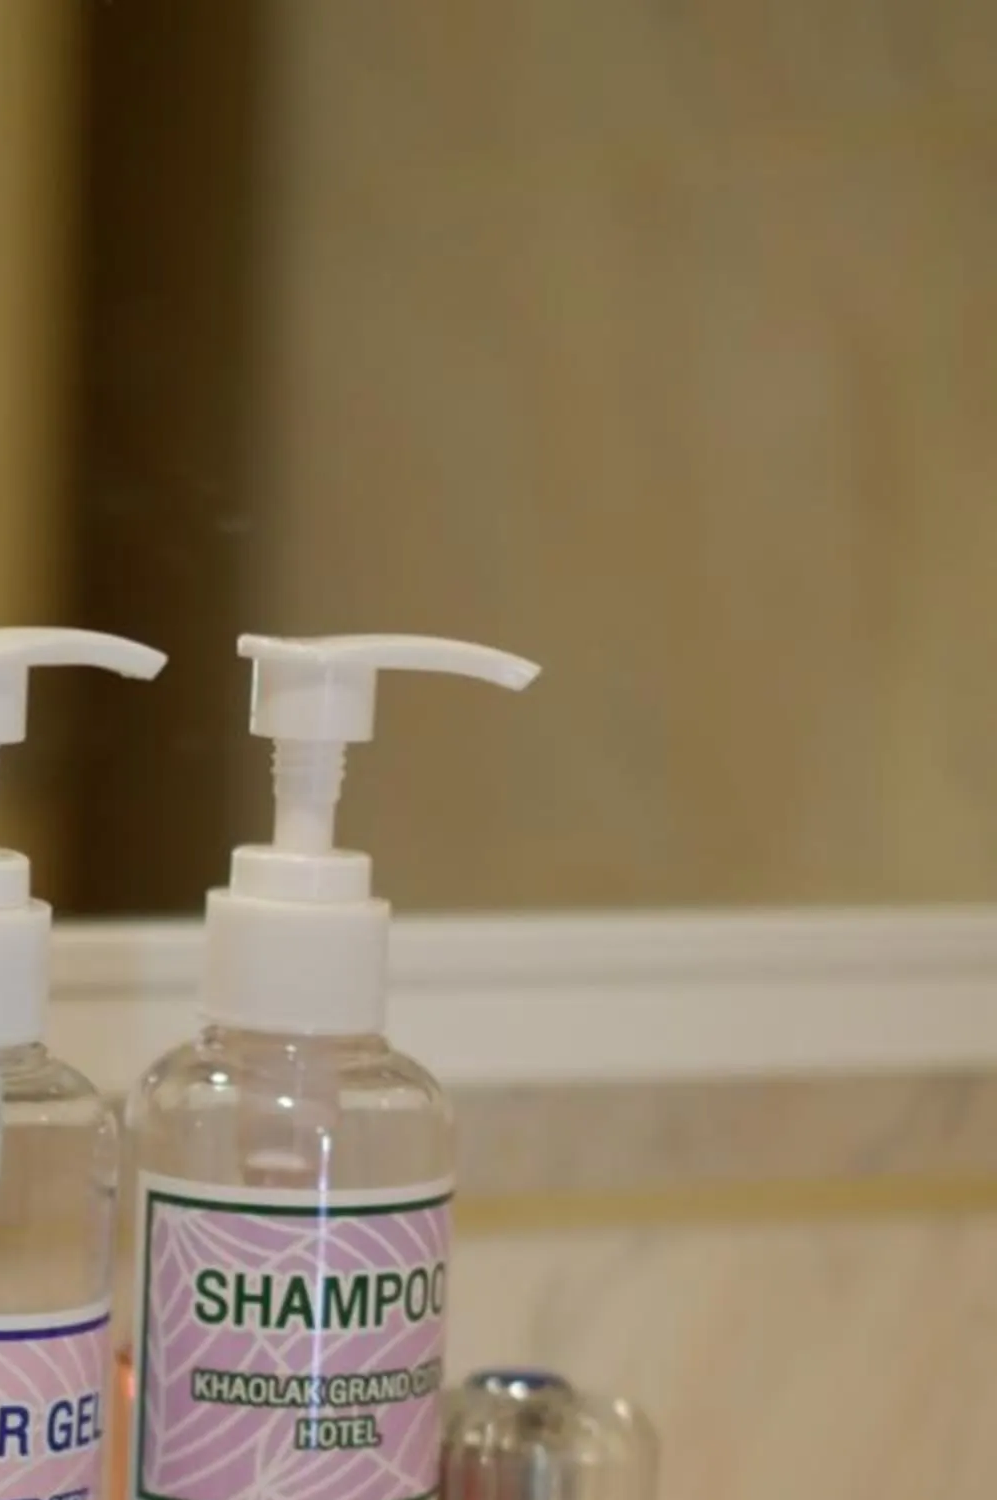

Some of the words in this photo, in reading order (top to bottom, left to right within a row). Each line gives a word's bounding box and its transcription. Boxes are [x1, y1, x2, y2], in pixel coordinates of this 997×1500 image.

[192, 1367, 325, 1406] KHAOLAK
[327, 1369, 411, 1407] GRAND
[47, 1391, 102, 1452] GEL
[295, 1415, 382, 1450] HOTEL
